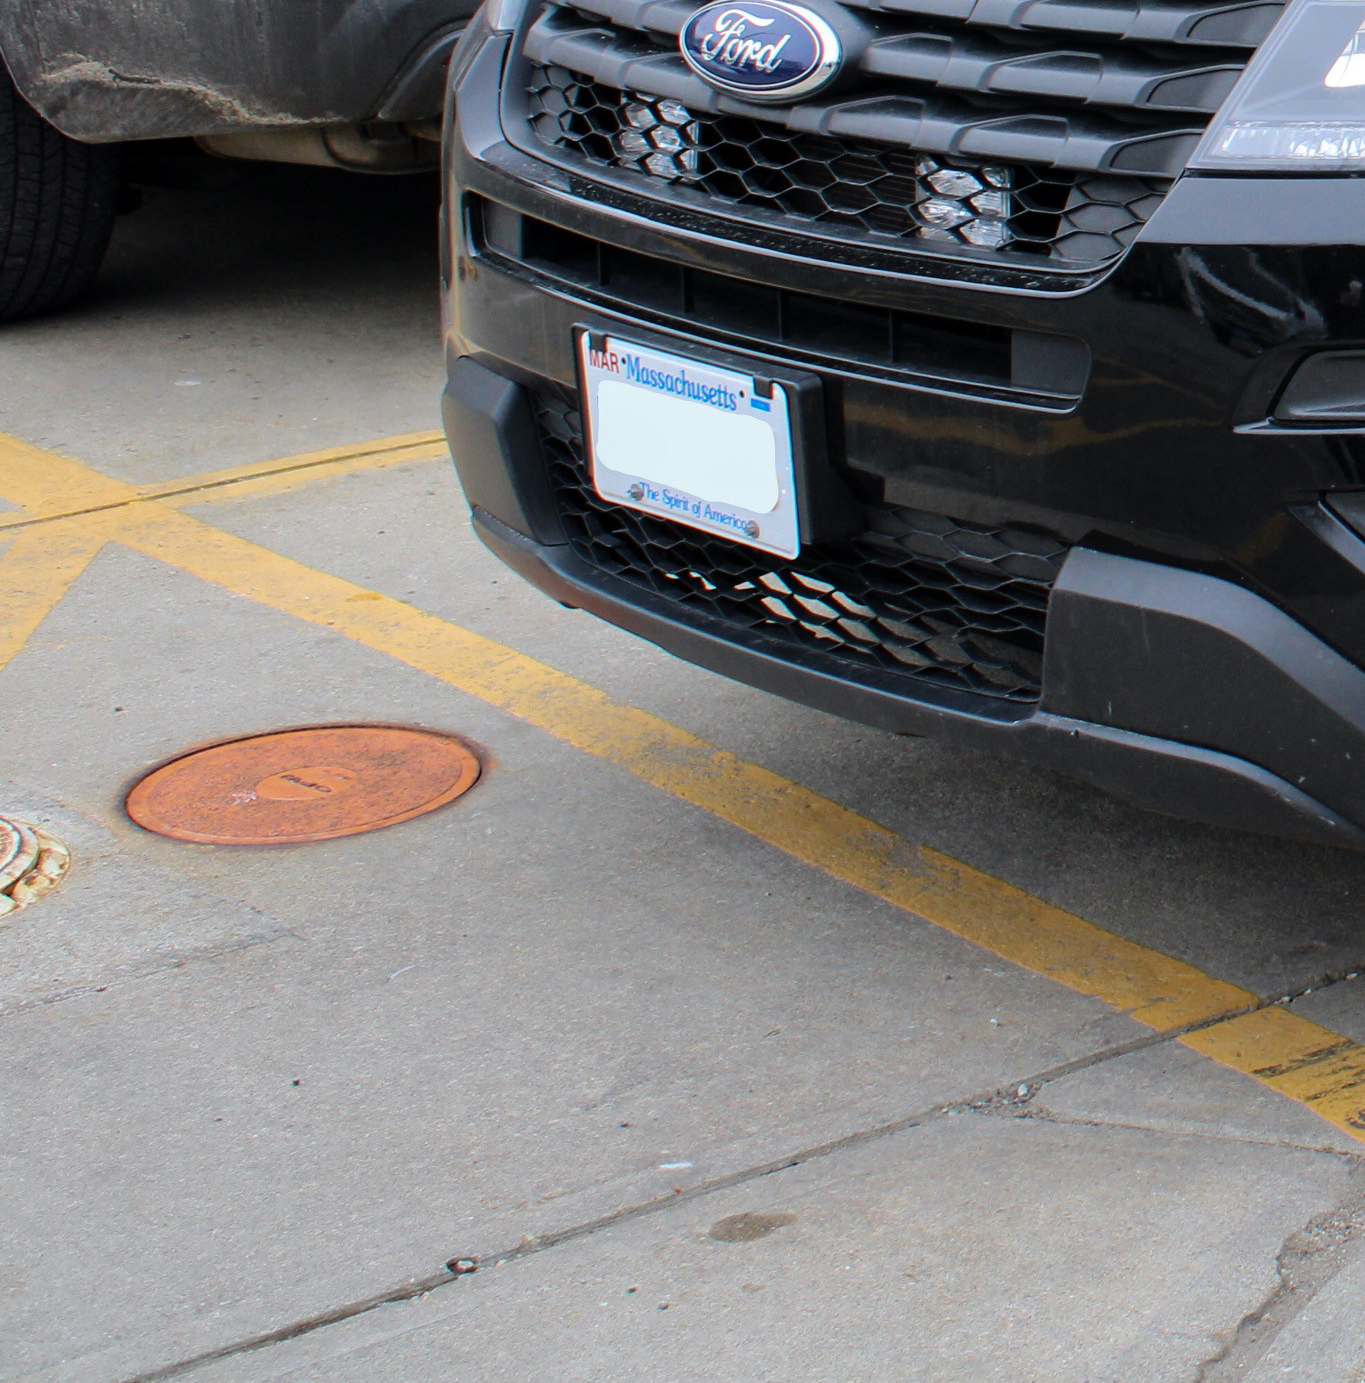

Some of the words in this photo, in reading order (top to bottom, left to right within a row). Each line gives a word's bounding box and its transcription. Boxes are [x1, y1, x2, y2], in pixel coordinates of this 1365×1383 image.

[700, 8, 792, 74] Ford
[588, 349, 621, 375] MAR
[624, 353, 738, 412] Massachusetts
[639, 481, 661, 503] The
[661, 488, 690, 512] Spirit
[691, 499, 703, 519] of
